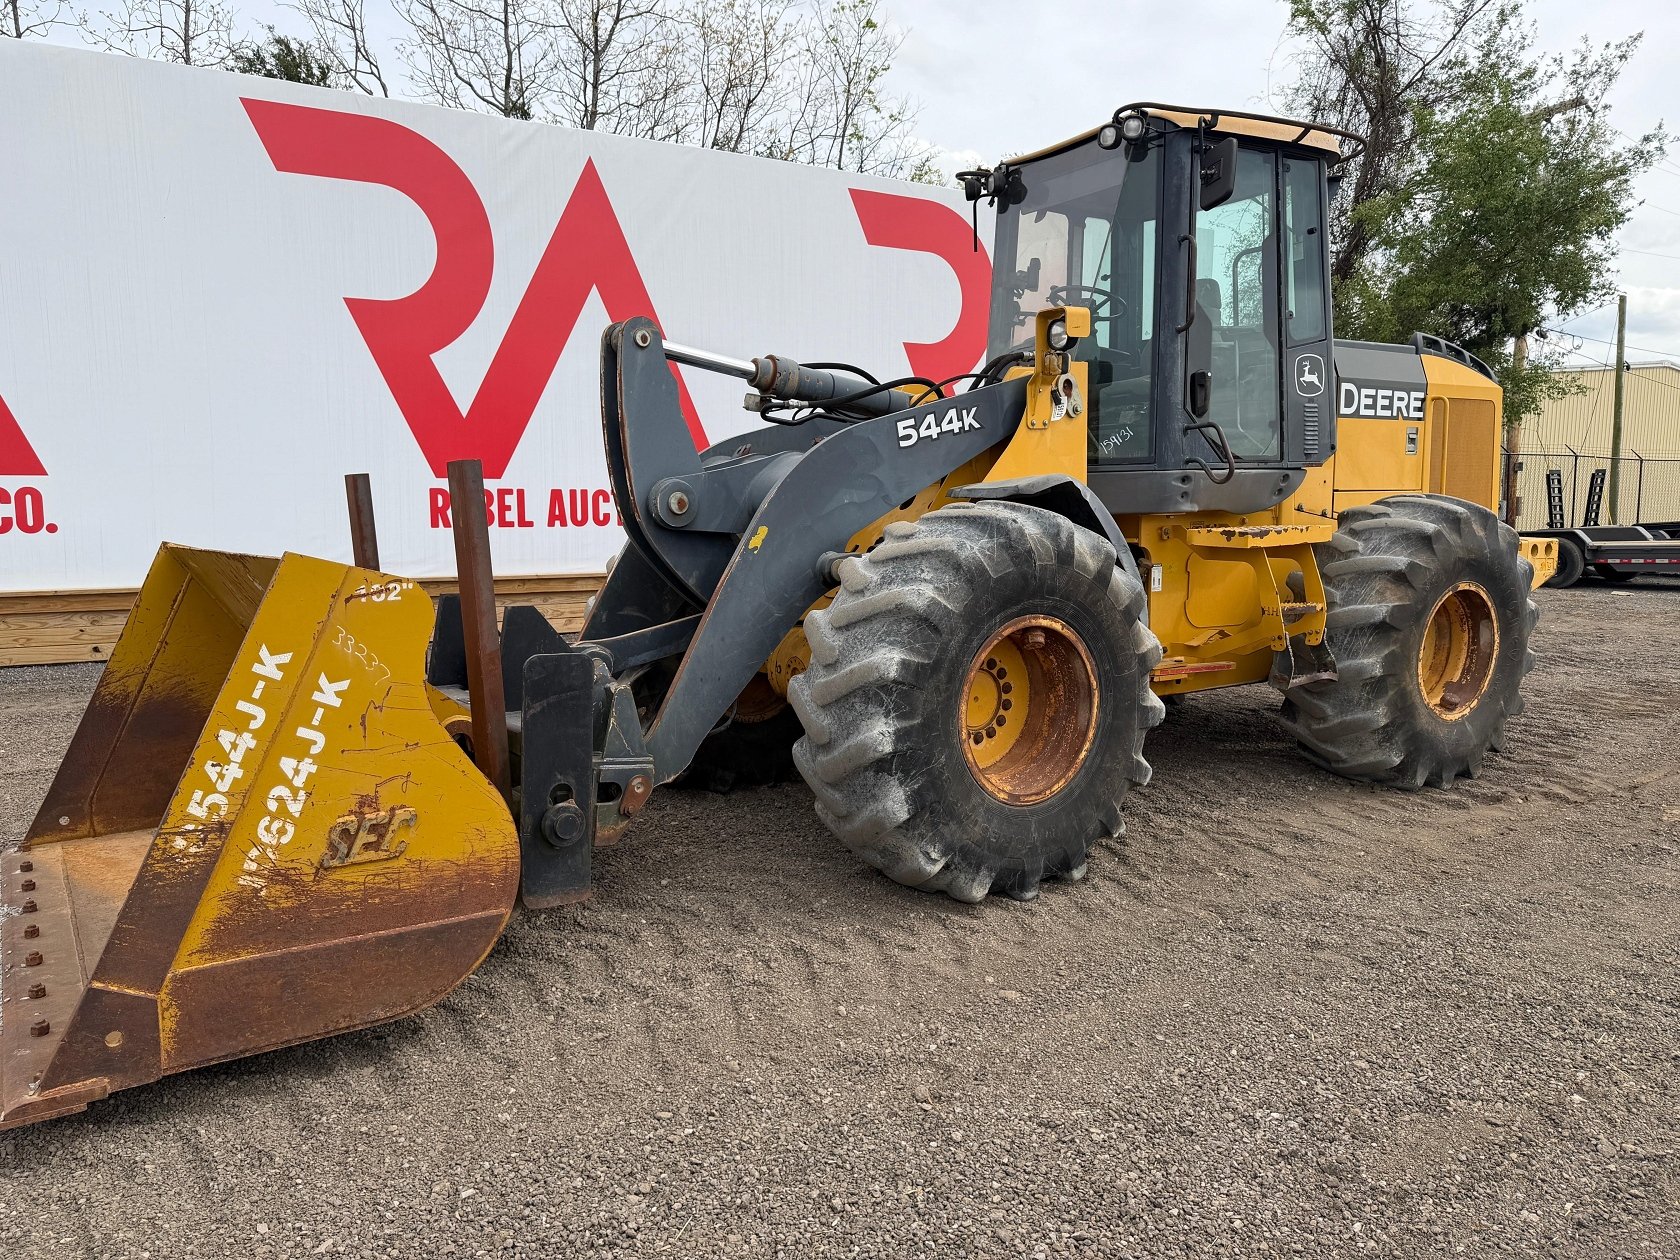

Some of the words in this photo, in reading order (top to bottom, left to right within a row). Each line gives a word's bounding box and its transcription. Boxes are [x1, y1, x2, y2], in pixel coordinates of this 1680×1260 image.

[1340, 382, 1424, 418] DEERE
[896, 406, 981, 448] 544K
[1100, 426, 1134, 455] 159131
[429, 487, 534, 528] REL
[321, 807, 418, 871] SEC
